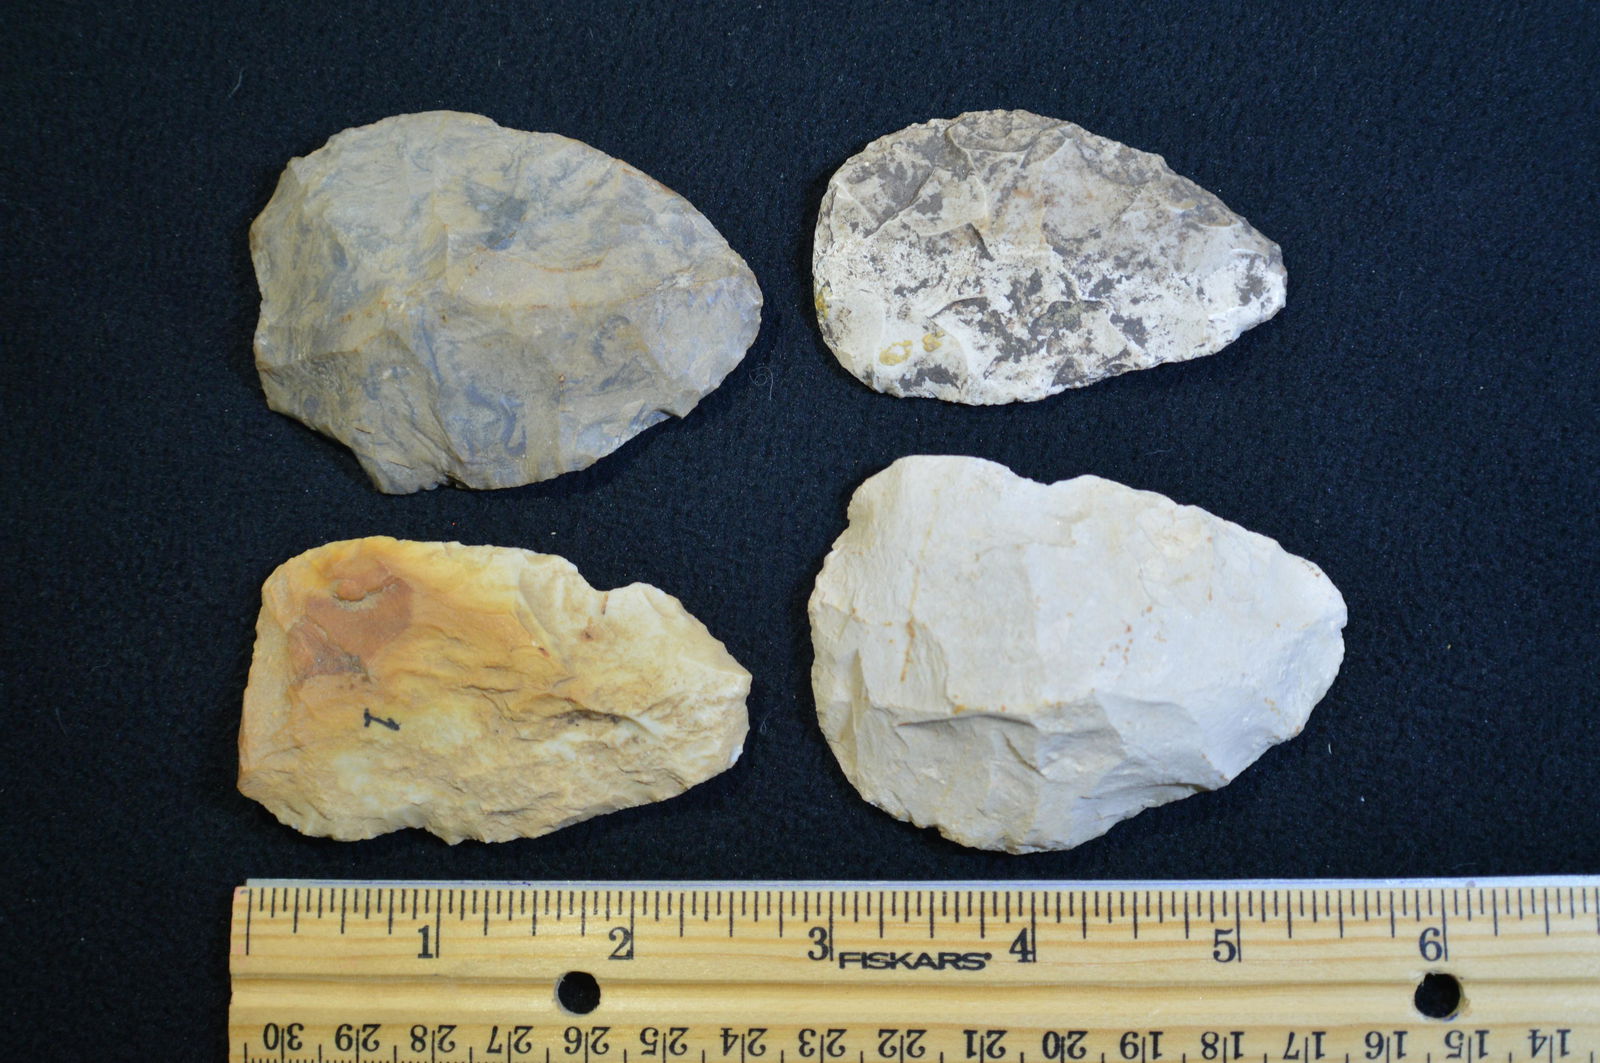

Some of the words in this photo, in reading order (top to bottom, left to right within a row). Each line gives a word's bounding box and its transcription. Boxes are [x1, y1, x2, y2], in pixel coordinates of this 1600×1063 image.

[416, 925, 434, 958] 1
[608, 927, 631, 959] 2
[807, 927, 829, 960] 3
[1009, 927, 1032, 962] 4
[1213, 928, 1236, 962] 5
[1418, 928, 1442, 962] 6
[838, 952, 990, 970] FISKARS
[264, 1023, 303, 1049] 30
[334, 1023, 381, 1053] 29
[410, 1024, 457, 1054] 28
[486, 1025, 533, 1054] 27
[563, 1025, 610, 1055] 26
[639, 1026, 688, 1056] 25
[720, 1027, 767, 1056] 24
[798, 1027, 846, 1057] 23
[877, 1027, 927, 1058] 22
[964, 1029, 1006, 1059] 21
[1042, 1029, 1087, 1059] 20
[1120, 1029, 1163, 1059] 19
[1202, 1029, 1244, 1059] 18
[1283, 1029, 1326, 1059] 17
[1365, 1029, 1408, 1059] 16
[1445, 1029, 1489, 1059] 15
[1528, 1028, 1571, 1057] 14
